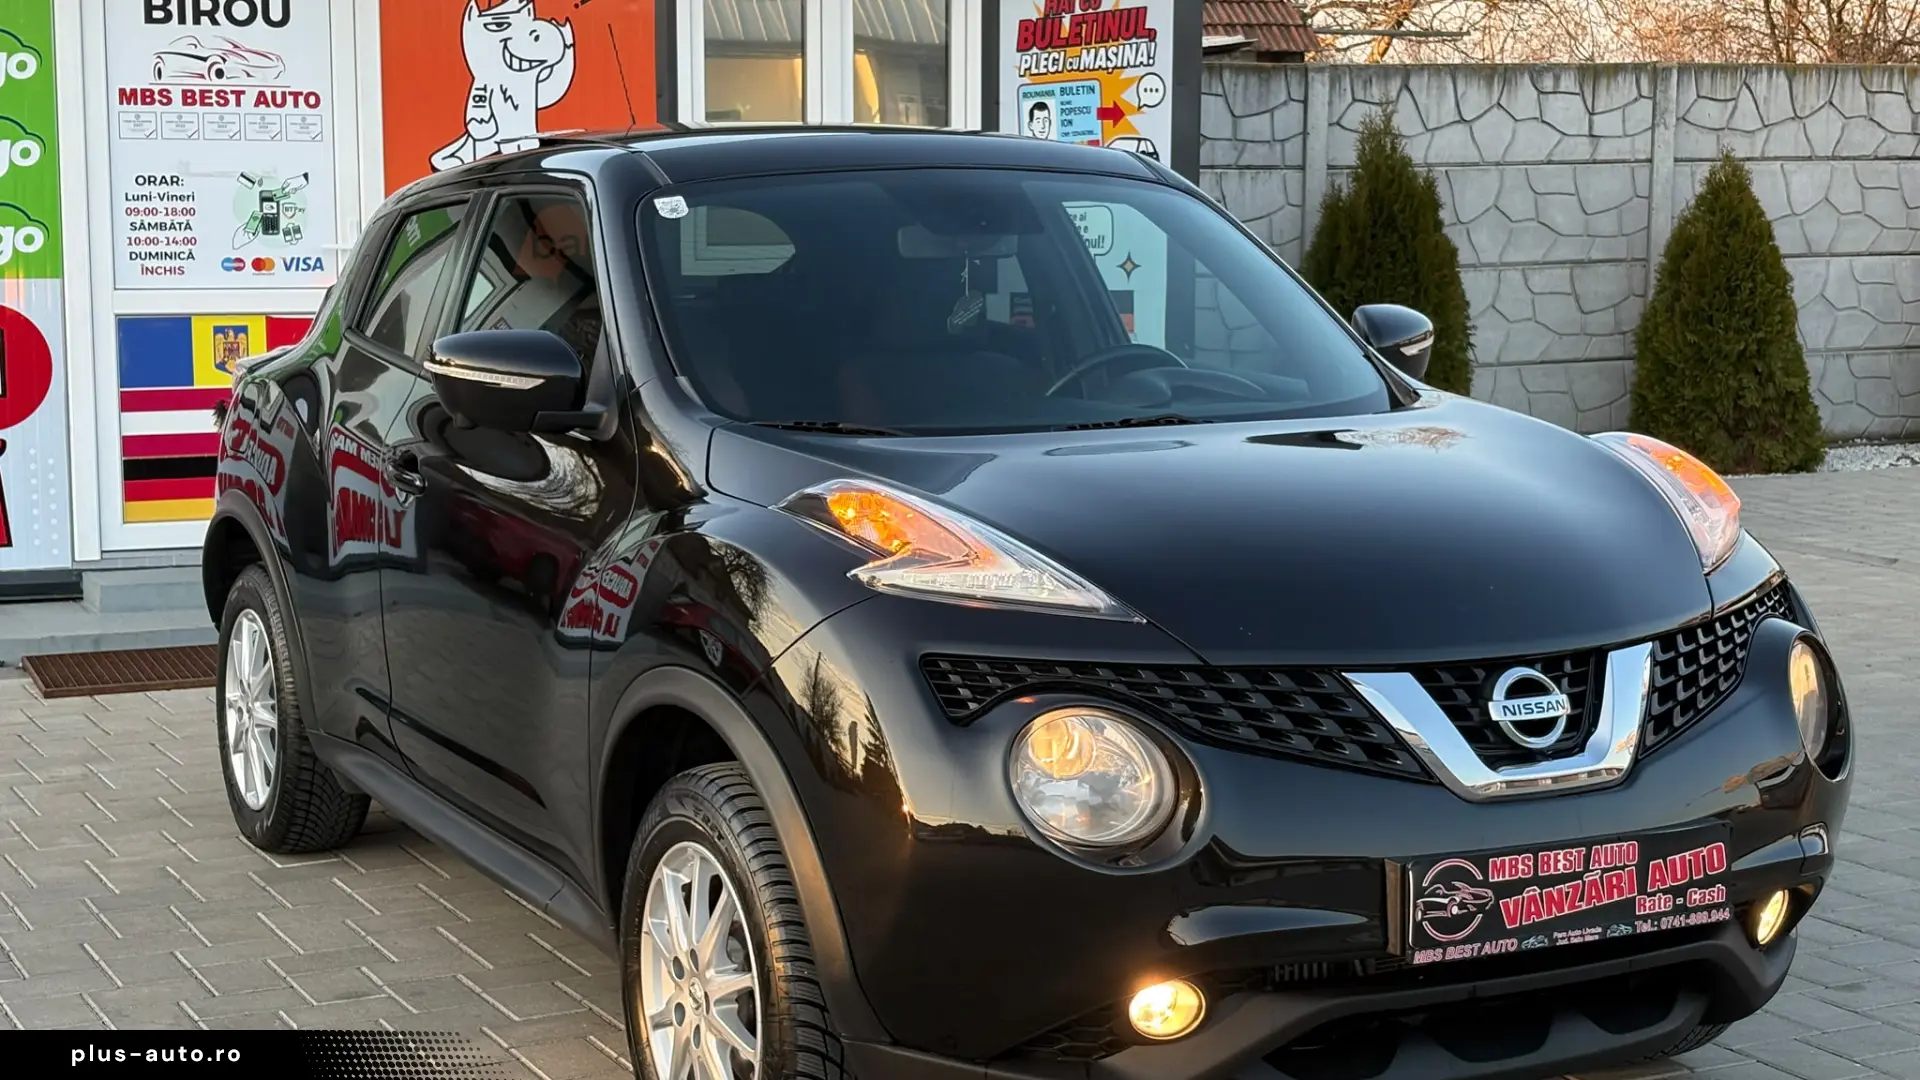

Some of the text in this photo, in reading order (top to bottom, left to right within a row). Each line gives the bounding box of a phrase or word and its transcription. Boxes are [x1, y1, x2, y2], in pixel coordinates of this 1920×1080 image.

[143, 0, 292, 28] BIROU
[1017, 6, 1157, 51] BULETINUL,
[1020, 51, 1066, 76] PLECI
[1080, 41, 1156, 74] MAȘINA!
[118, 88, 321, 109] MBS BEST AUTO
[1060, 85, 1096, 96] BULETIN
[1060, 106, 1092, 117] POPESCU
[1061, 119, 1073, 128] ION
[134, 174, 185, 187] ORAR:
[124, 191, 196, 202] Luni-Vineri
[125, 207, 196, 217] 09:00-18:00
[126, 236, 198, 246] 10:00-14:00
[129, 249, 196, 261] DUMINICĂ
[140, 263, 185, 276] ÎNCHIS
[281, 256, 325, 272] VISA
[1502, 699, 1566, 717] NISSAN
[1489, 841, 1638, 881] MBS BEST AUTO
[1648, 842, 1727, 892] AUTO
[1635, 894, 1673, 915] Rate
[1687, 884, 1726, 907] Cash
[1413, 938, 1518, 964] MBS BEST AUTO
